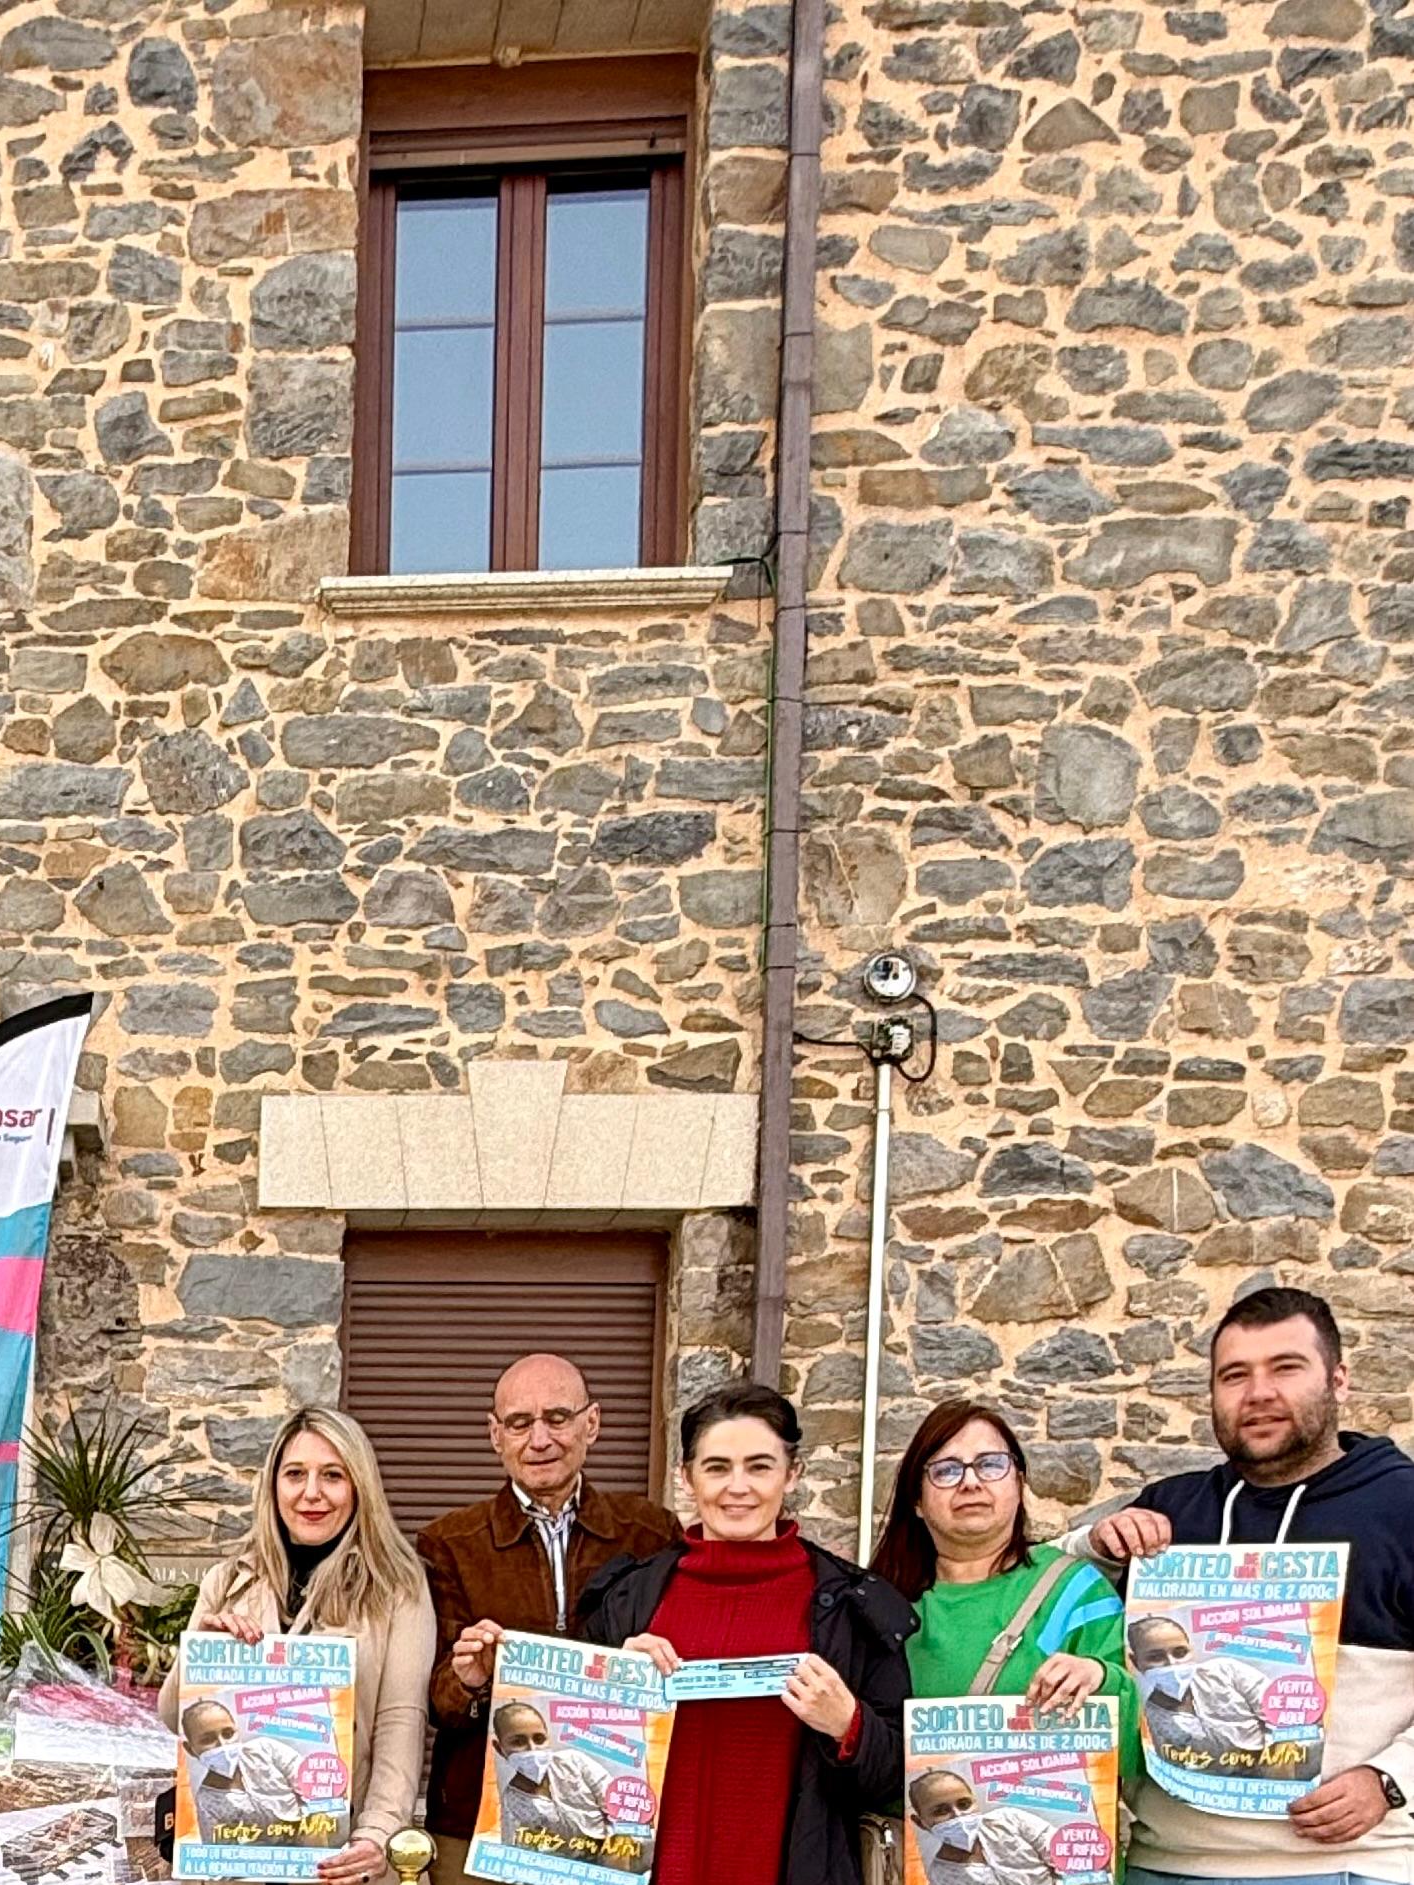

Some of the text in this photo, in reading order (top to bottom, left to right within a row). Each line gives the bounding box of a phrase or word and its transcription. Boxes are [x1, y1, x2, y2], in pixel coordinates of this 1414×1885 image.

[1135, 1551, 1232, 1578] SORTEO
[1260, 1551, 1340, 1578] CESTA
[1137, 1582, 1206, 1597] VALORADA
[1209, 1583, 1228, 1598] EN
[1264, 1584, 1284, 1600] DE
[186, 1640, 263, 1664] SORTEO
[288, 1641, 350, 1667] CESTA
[502, 1638, 583, 1676] SORTEO
[606, 1656, 663, 1693] CEST
[189, 1668, 245, 1682] VALORADA
[248, 1669, 262, 1683] EN
[292, 1670, 307, 1685] DE
[504, 1667, 561, 1691] VALORADA
[564, 1678, 580, 1695] EN
[609, 1687, 626, 1704] DE
[1275, 1682, 1315, 1695] VENTA
[1268, 1696, 1284, 1709] DE
[911, 1704, 1004, 1732] SORTEO
[915, 1736, 981, 1752] VALORADA
[987, 1736, 1003, 1750] EN
[1041, 1735, 1059, 1750] DE
[1219, 1754, 1254, 1767] con
[1062, 1830, 1098, 1841] VENTA
[1056, 1844, 1070, 1856] DE
